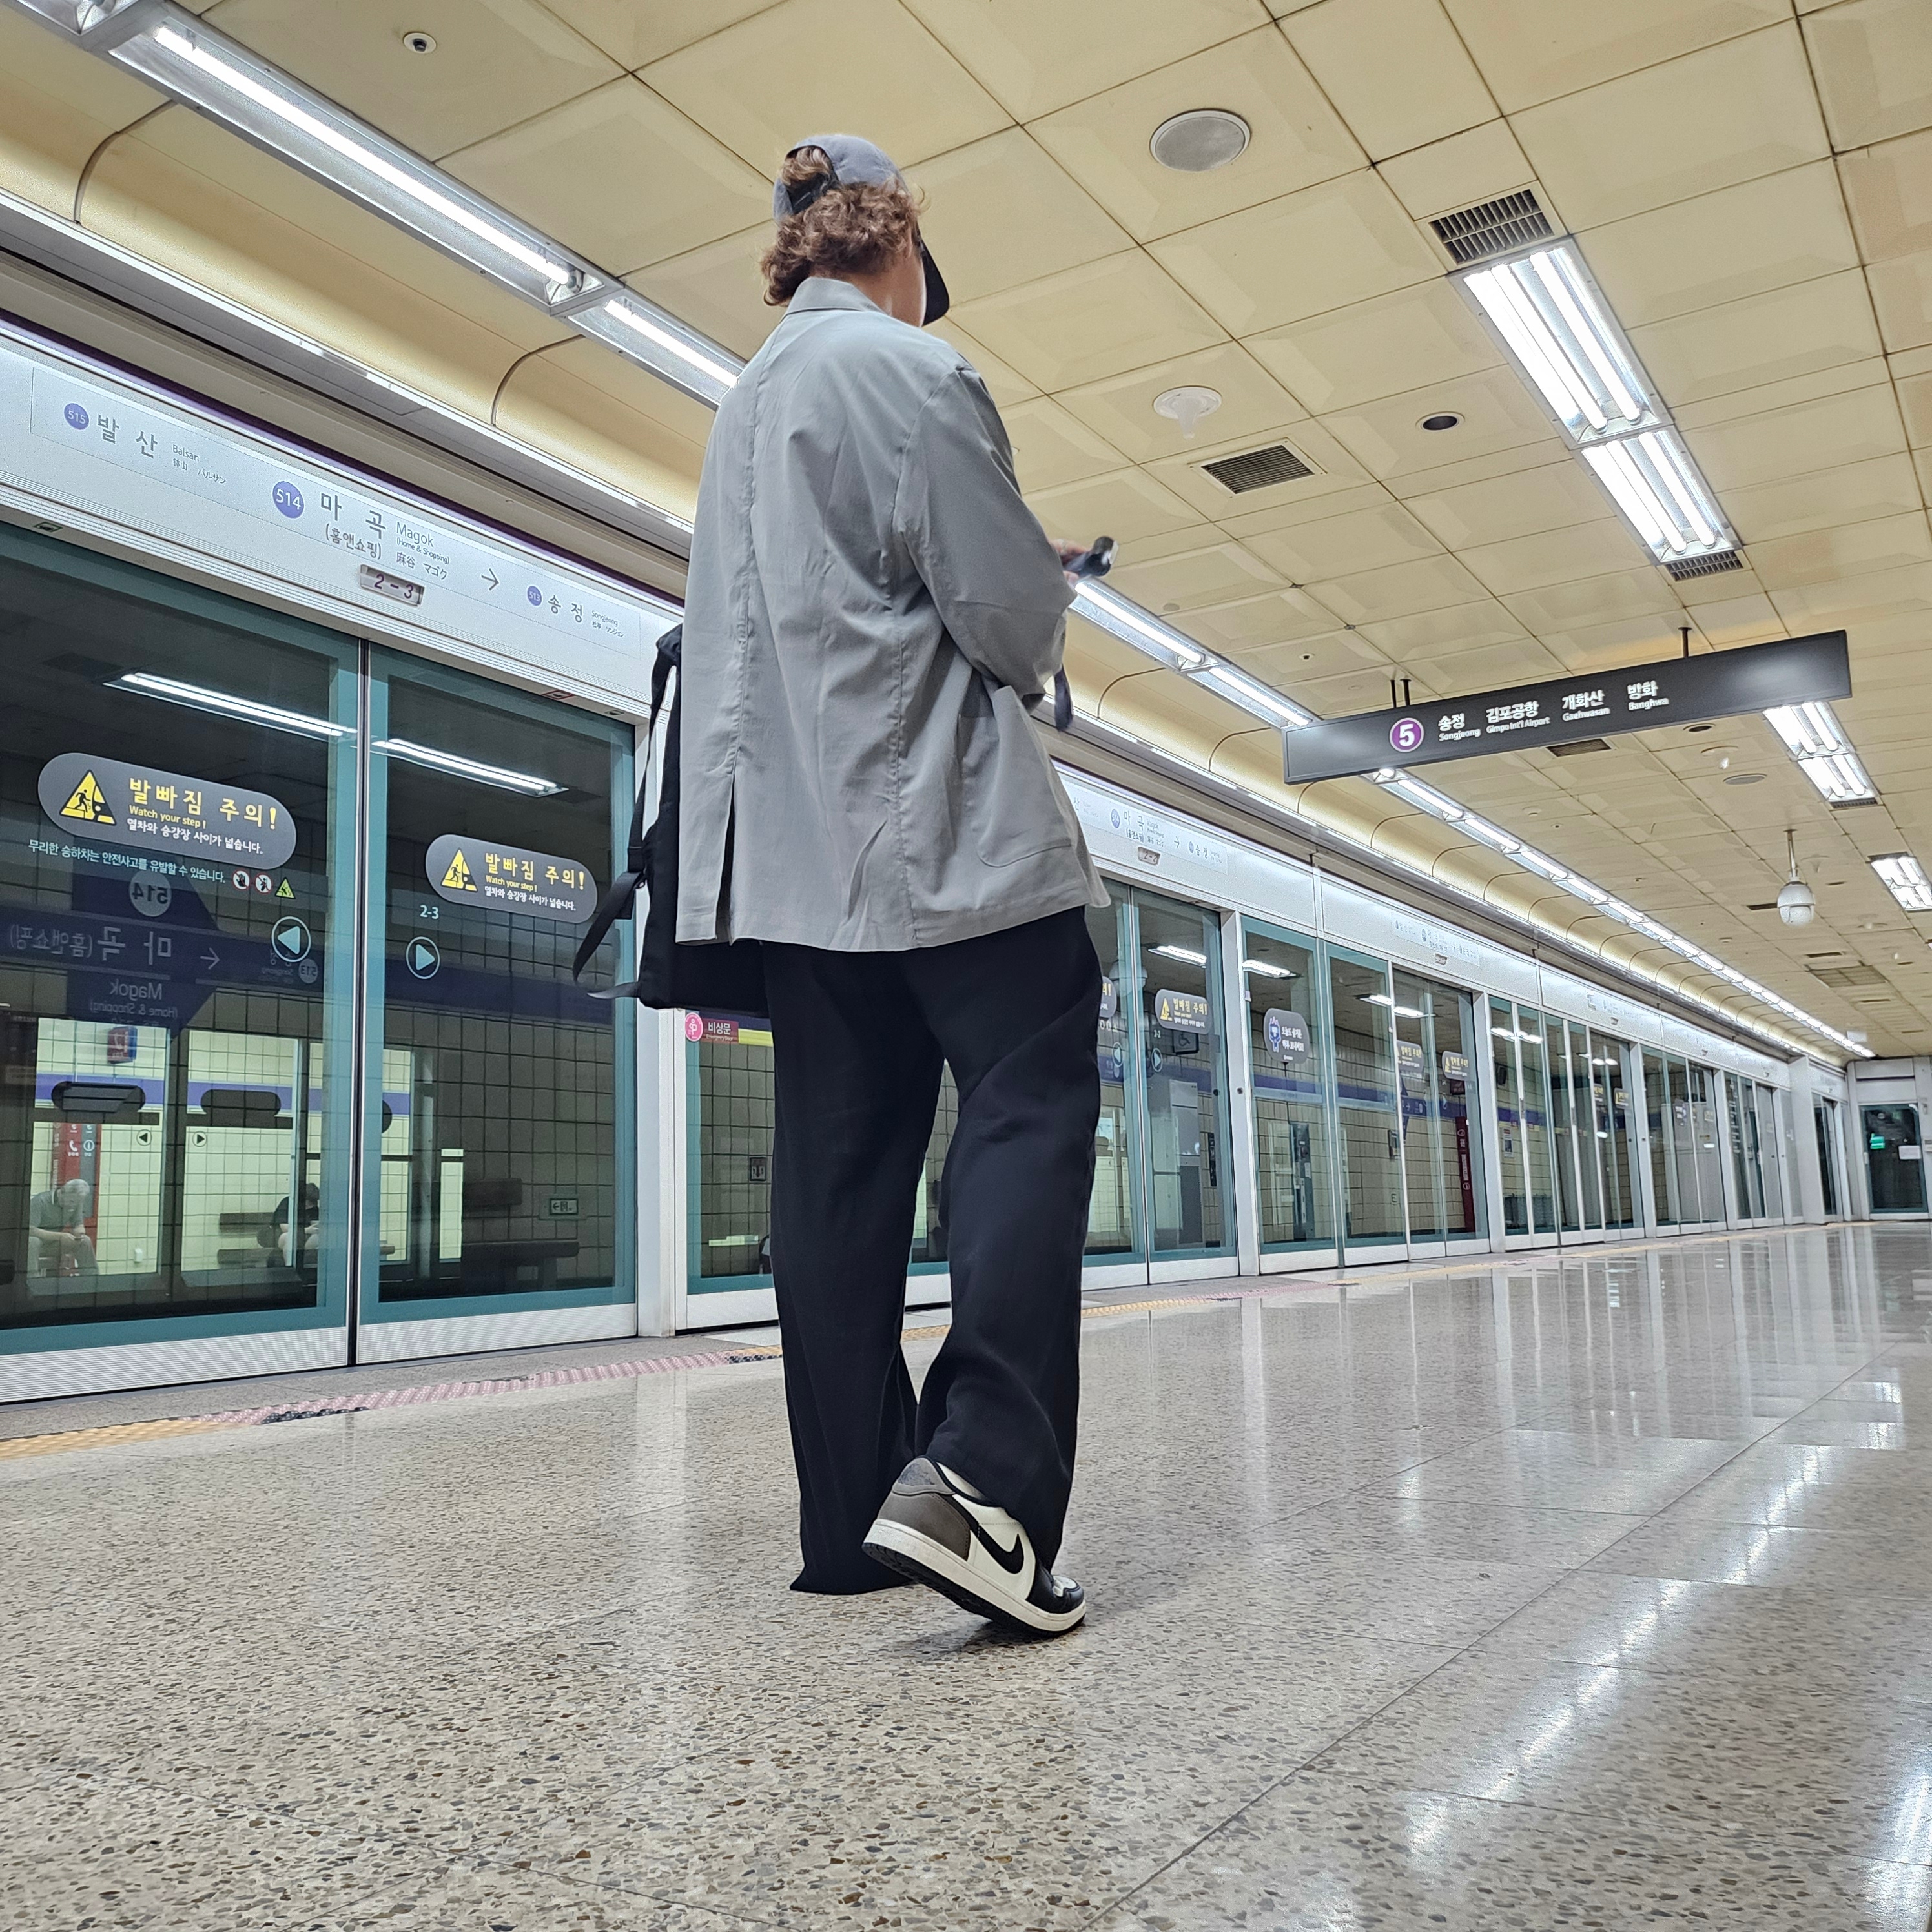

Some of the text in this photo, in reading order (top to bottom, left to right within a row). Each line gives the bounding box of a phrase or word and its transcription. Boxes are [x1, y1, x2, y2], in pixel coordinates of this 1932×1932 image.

[68, 409, 86, 424] 515
[172, 444, 200, 462] Balsan
[276, 489, 302, 511] 514
[325, 523, 382, 560] (홈앤쇼핑)
[396, 522, 434, 548] Magok
[396, 537, 449, 565] (Home & Shopping)
[396, 551, 416, 569] 麻谷
[423, 563, 447, 580] マゴク
[529, 591, 540, 602] 513
[1399, 680, 1658, 746] 5 송정 김포공항 개화산 방화
[1439, 728, 1481, 741] Songjeong
[1486, 723, 1510, 734] Gimpo
[1525, 717, 1550, 729] Airport
[1562, 707, 1610, 721] Gaehwasan
[1629, 697, 1670, 711] Banghwa
[130, 777, 276, 830] 발빠짐 주의!
[130, 805, 158, 819] Watch
[160, 813, 181, 823] your
[127, 818, 263, 854] 열차와 승강장 사이가 넓습니다.
[28, 839, 226, 883] 무리한 승하차는 안전사고를 유발할 수 있습니다.
[486, 853, 584, 890] 발빠짐 주의!
[486, 875, 506, 886] Watch
[506, 879, 520, 889] your
[484, 885, 506, 898] 열차와
[506, 890, 528, 903] 승강장
[528, 894, 548, 907] 사이가
[420, 905, 439, 920] 2-3
[708, 1022, 732, 1036] 비상문
